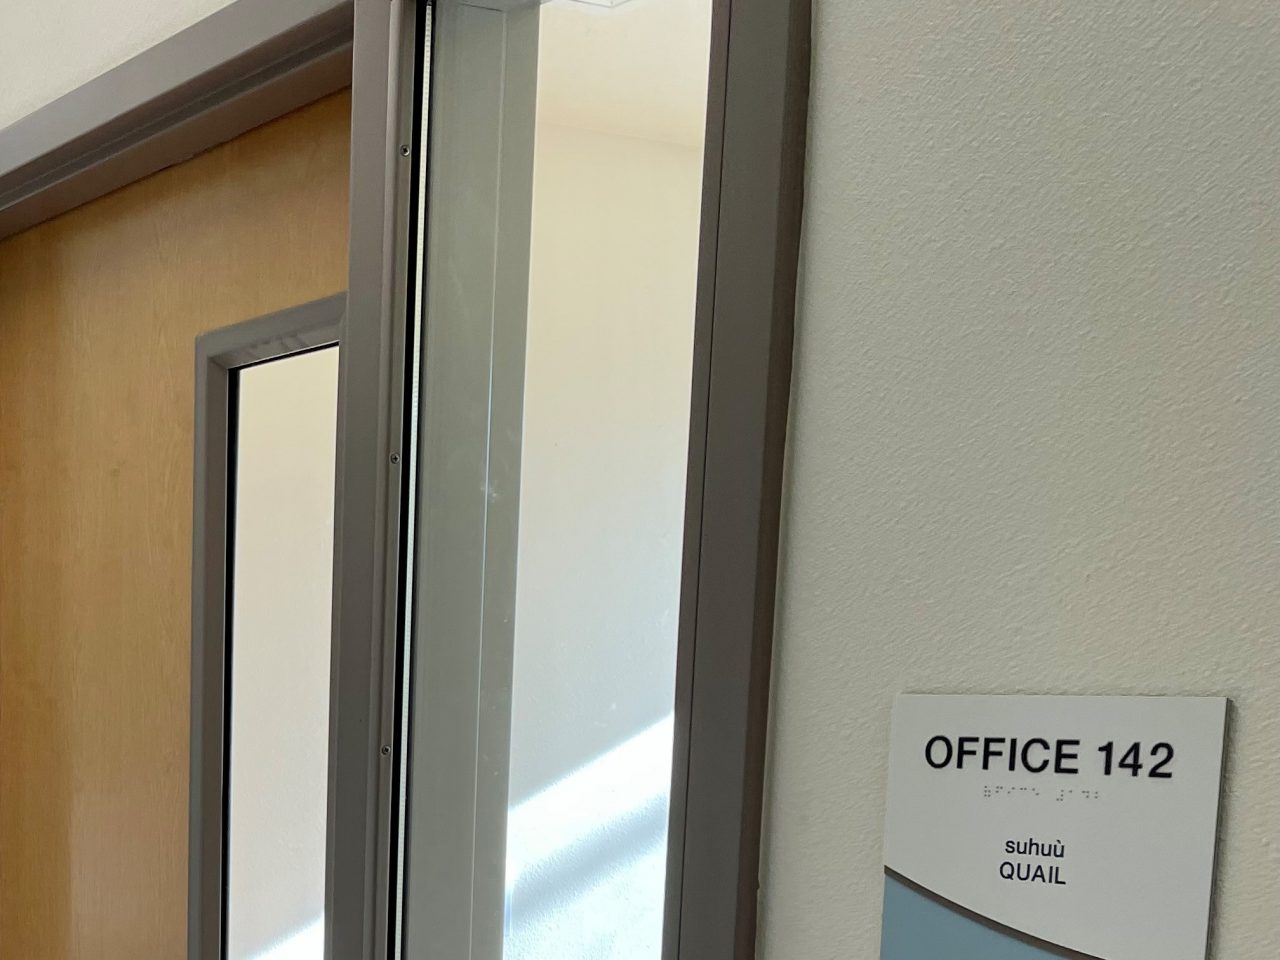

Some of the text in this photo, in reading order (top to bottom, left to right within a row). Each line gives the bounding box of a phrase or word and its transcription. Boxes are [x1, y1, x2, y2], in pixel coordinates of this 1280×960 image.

[924, 735, 1175, 779] OFFICE 142
[1004, 837, 1066, 858] suhuù
[999, 861, 1067, 885] QUAIL
